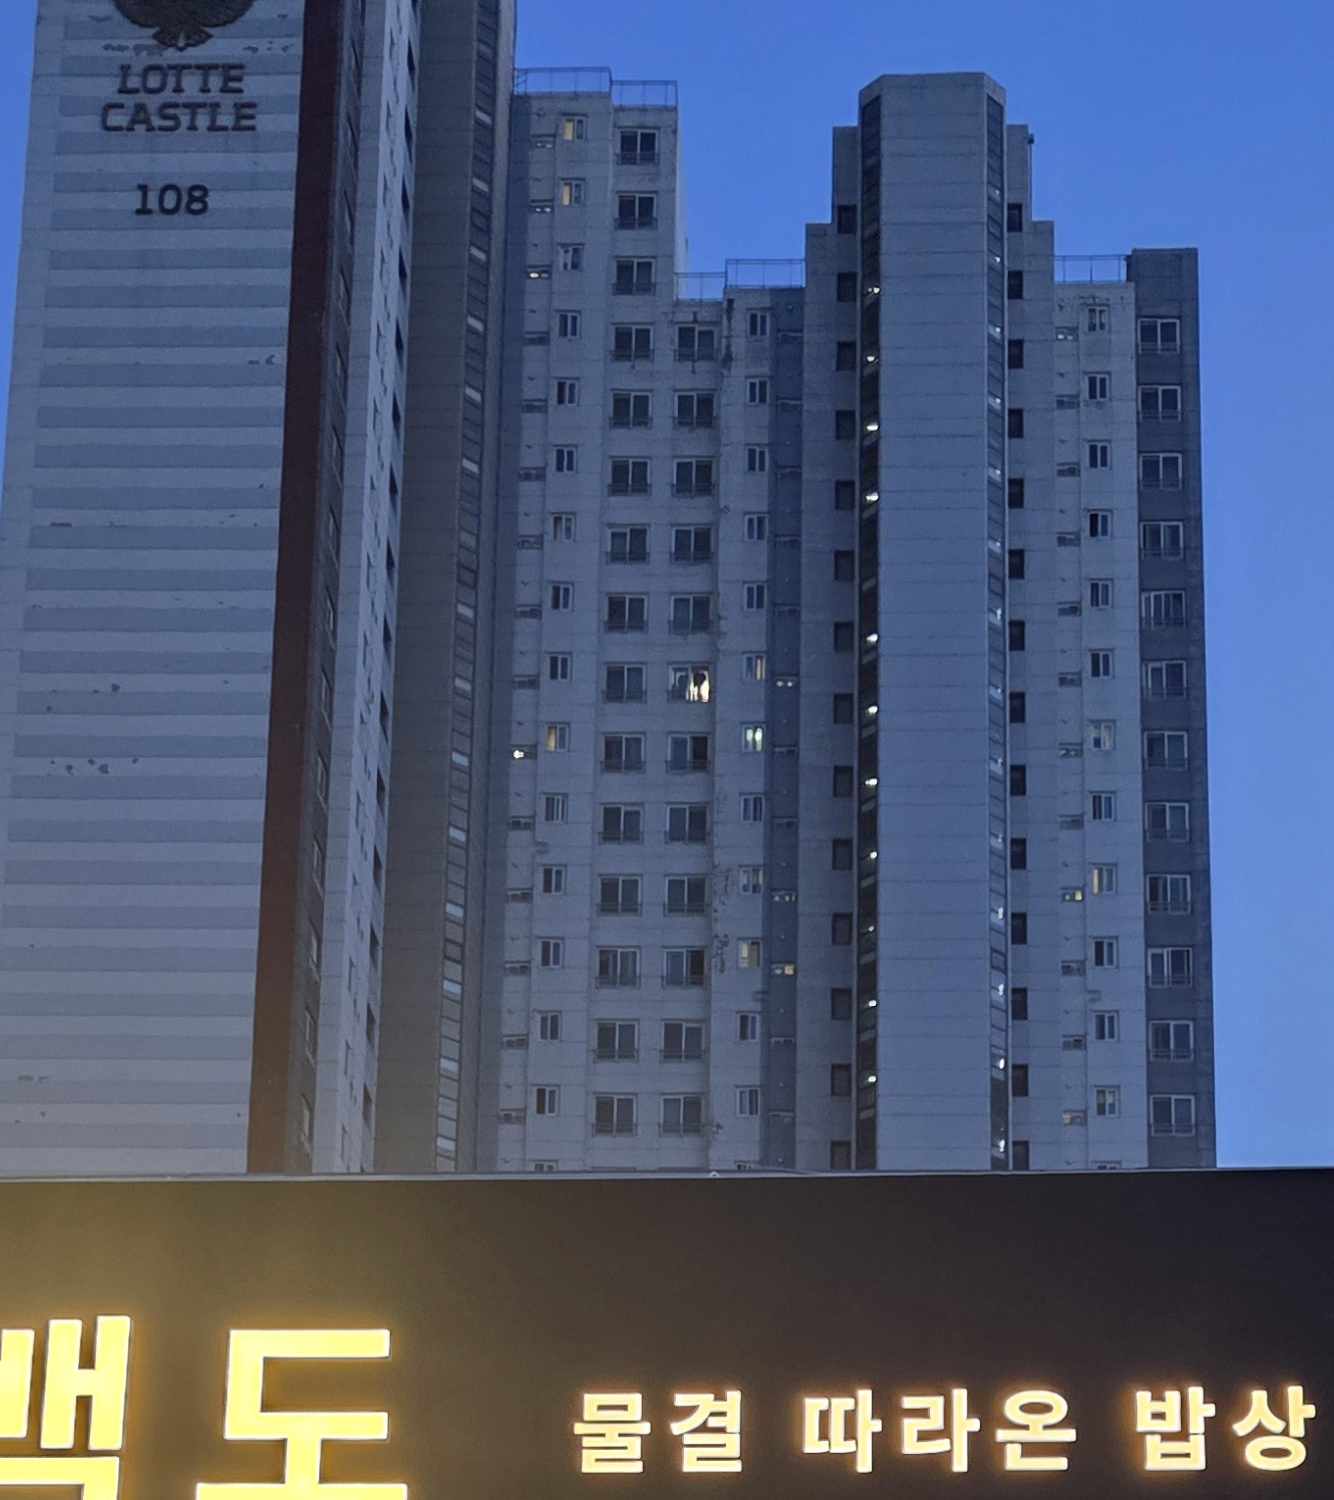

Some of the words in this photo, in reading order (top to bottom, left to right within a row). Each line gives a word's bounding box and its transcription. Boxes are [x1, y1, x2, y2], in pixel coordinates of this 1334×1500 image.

[117, 63, 246, 94] LOTTE
[101, 102, 258, 132] CASTLE
[134, 183, 210, 216] 108
[573, 1389, 743, 1474] 물결
[802, 1388, 1077, 1473] 따라온
[1135, 1385, 1317, 1471] 밥상
